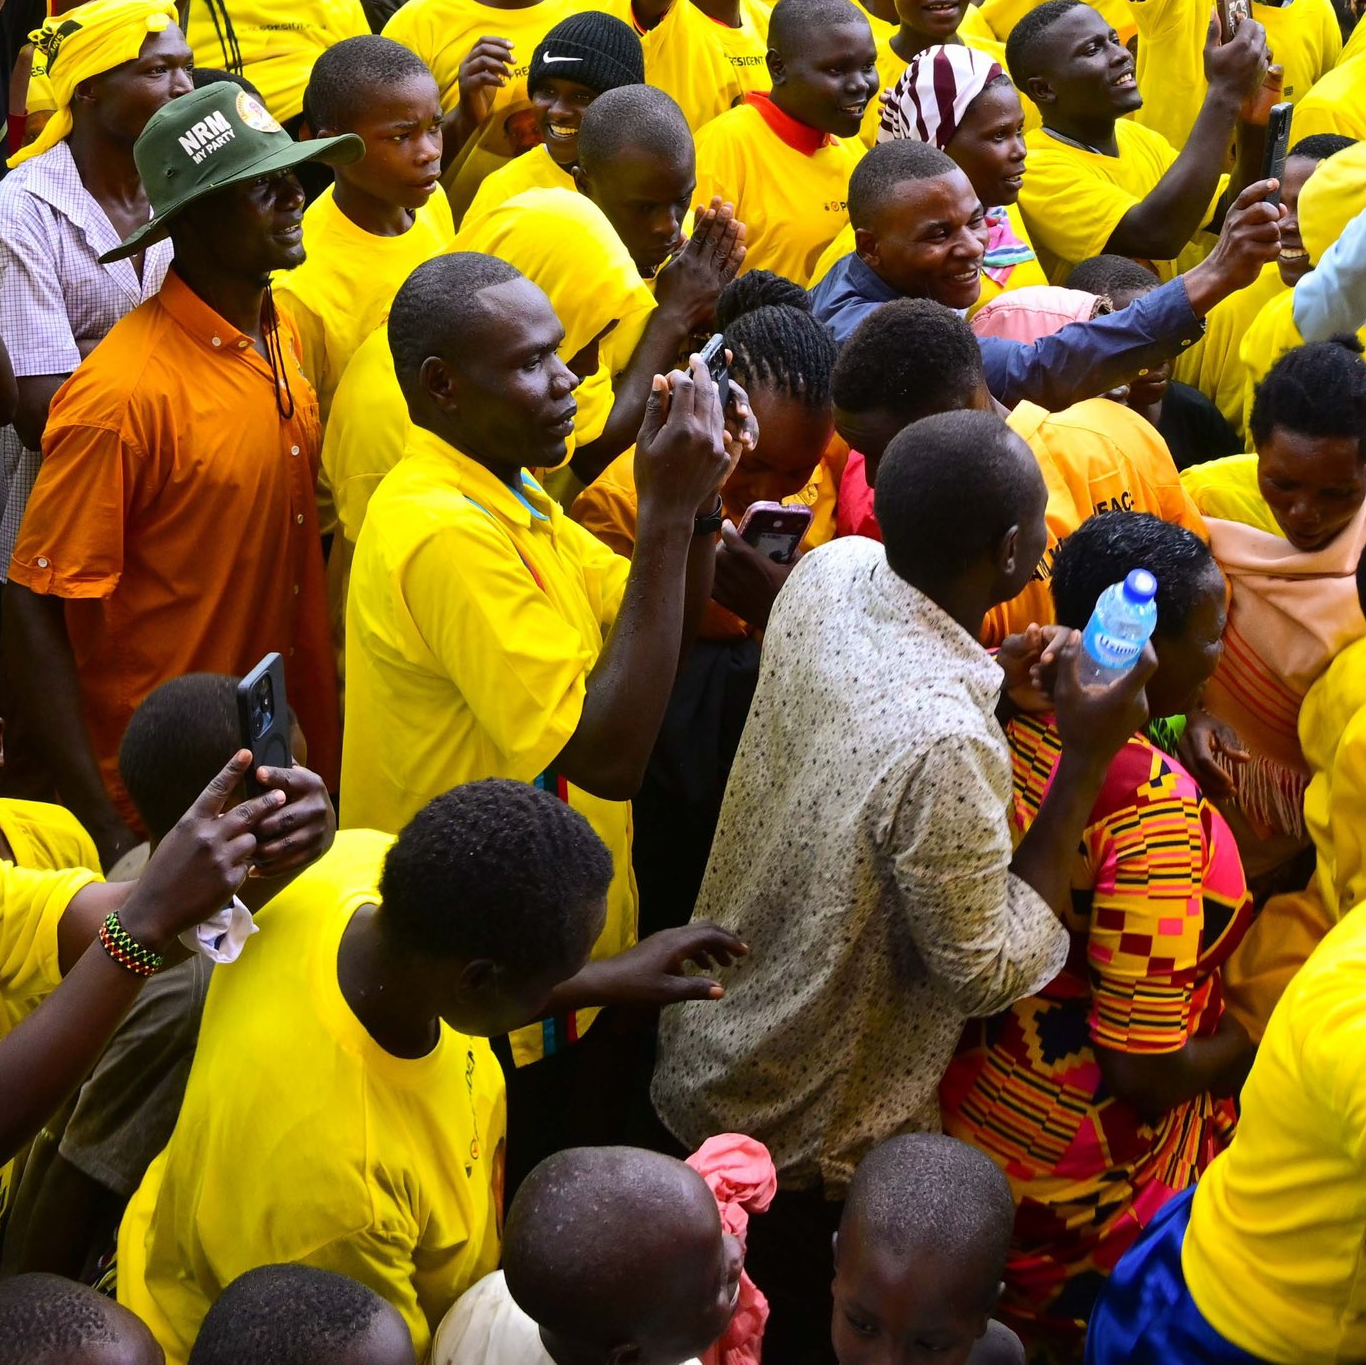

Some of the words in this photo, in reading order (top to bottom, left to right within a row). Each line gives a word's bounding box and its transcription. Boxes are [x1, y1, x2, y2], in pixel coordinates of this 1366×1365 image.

[177, 110, 232, 155] NRM
[192, 148, 208, 165] MY
[205, 129, 237, 155] PARTY
